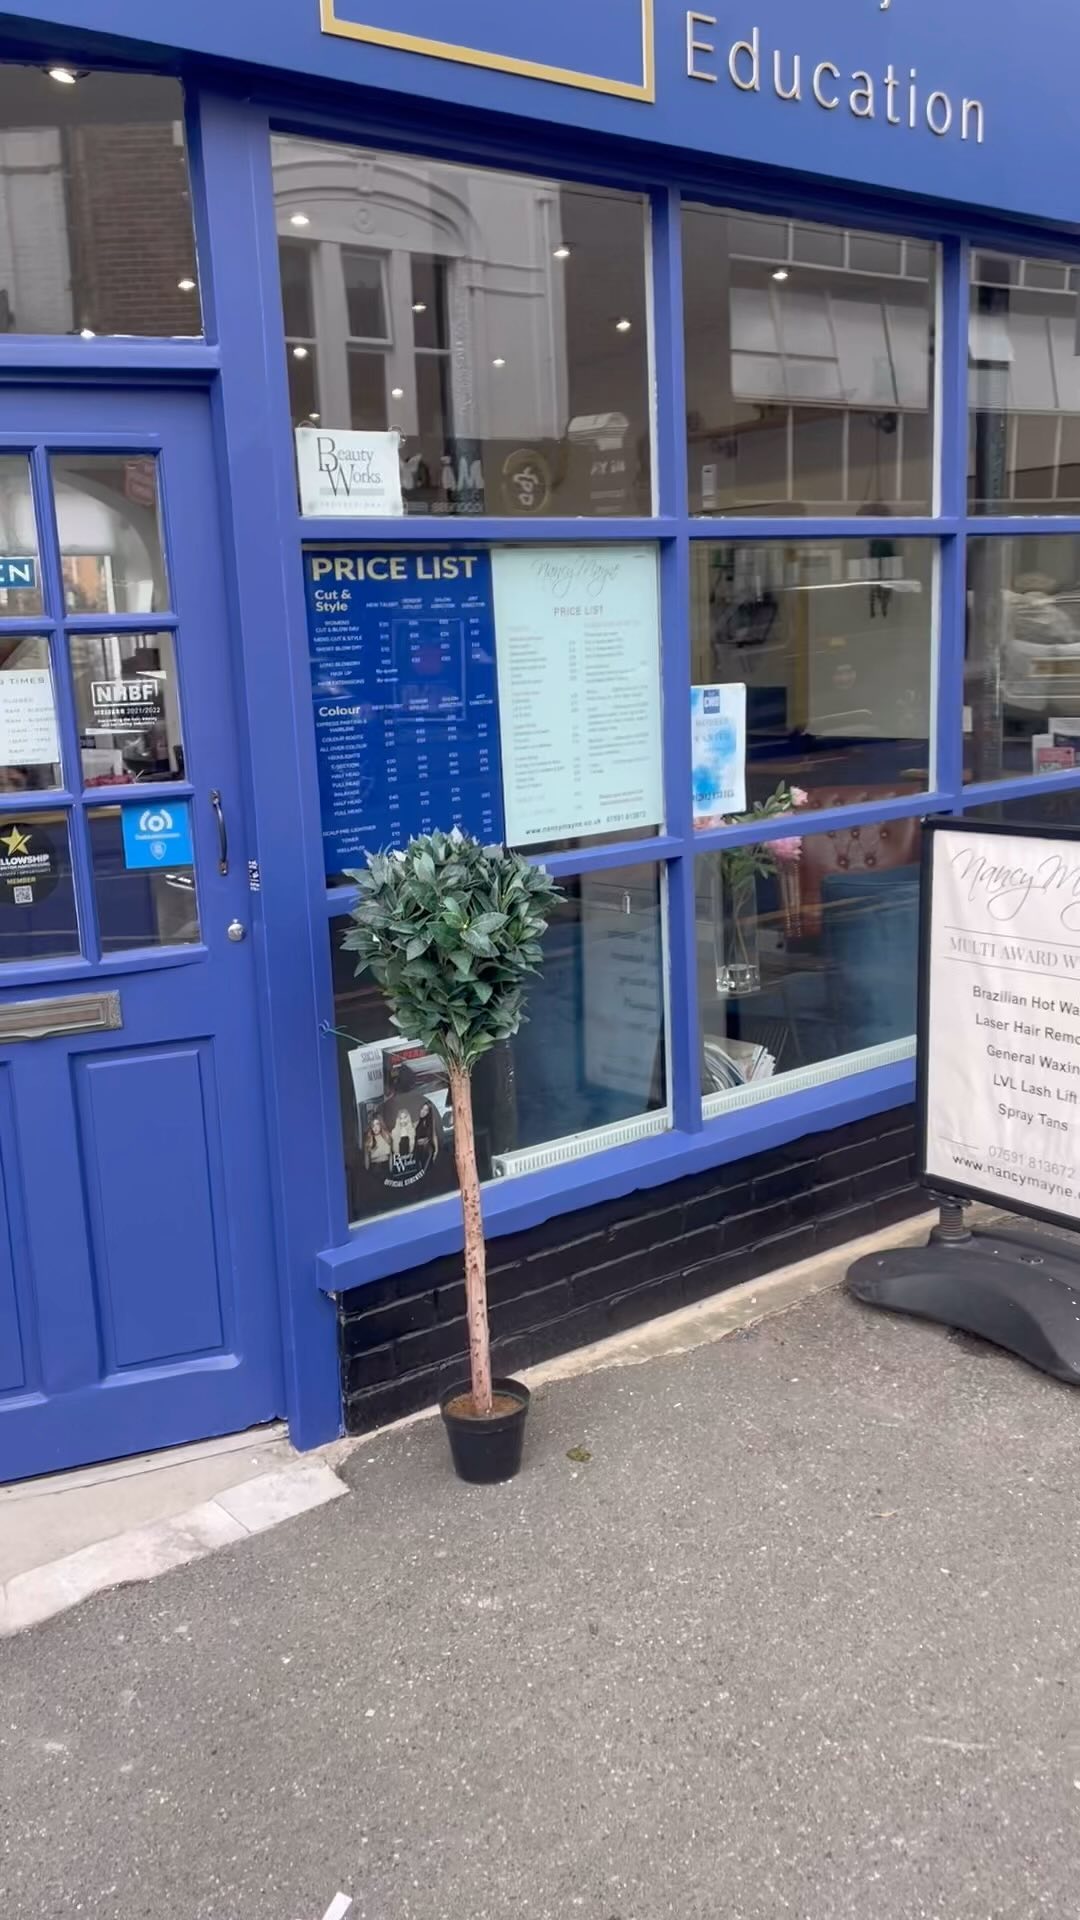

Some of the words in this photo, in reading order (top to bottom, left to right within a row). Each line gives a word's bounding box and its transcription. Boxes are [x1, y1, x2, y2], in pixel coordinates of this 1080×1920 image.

[686, 10, 985, 144] Education
[316, 436, 375, 472] Beauty
[311, 557, 408, 581] PRICE
[416, 556, 478, 580] LIST
[314, 589, 338, 601] Cut
[341, 589, 352, 600] &
[315, 601, 348, 613] Style
[553, 606, 581, 617] PRICE
[584, 605, 604, 616] LIST
[10, 676, 45, 685] TIMES
[96, 684, 153, 702] NHBF
[127, 706, 161, 715] 2021/2022
[318, 706, 361, 717] Colour
[952, 848, 1037, 921] Nancy
[950, 936, 996, 958] MULTI
[1000, 946, 1058, 967] AWARD
[973, 985, 1027, 1007] Brazilian
[1031, 996, 1055, 1012] Hot
[1059, 1001, 1080, 1016] Wa
[975, 1013, 1010, 1031] Laser
[1014, 1021, 1041, 1037] Hair
[986, 1044, 1035, 1065] General
[993, 1074, 1017, 1090] LVL
[1021, 1080, 1051, 1098] Lash
[1057, 1087, 1077, 1104] Lift
[998, 1103, 1034, 1125] Spray
[1038, 1112, 1069, 1132] Tans
[988, 1145, 1024, 1165] 07591
[1028, 1155, 1076, 1180] 813672
